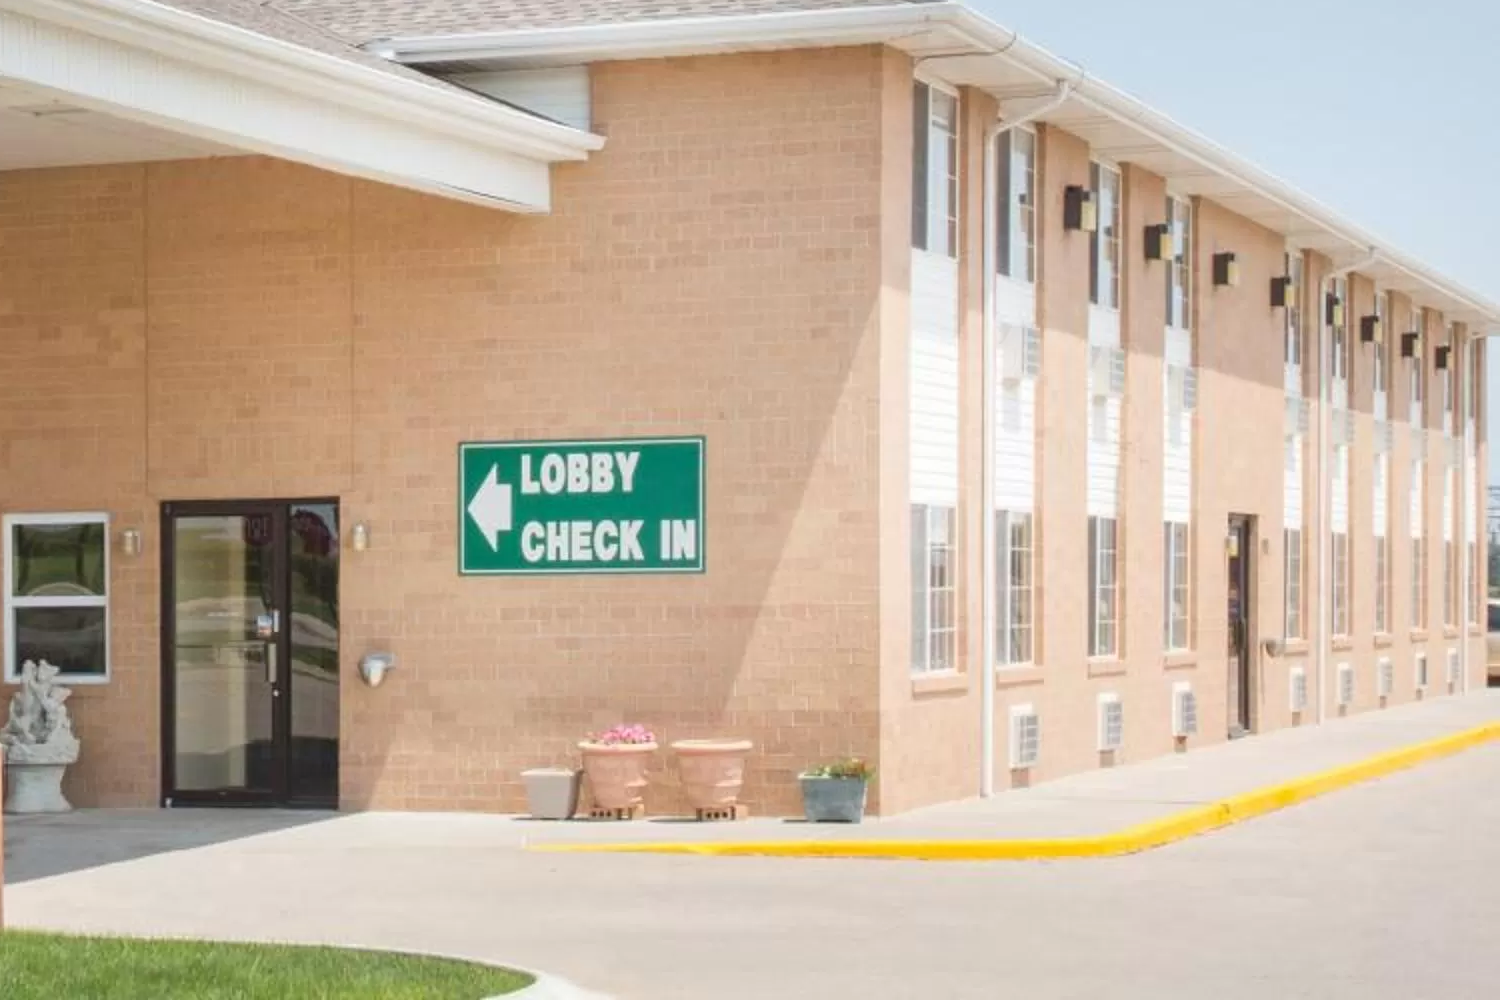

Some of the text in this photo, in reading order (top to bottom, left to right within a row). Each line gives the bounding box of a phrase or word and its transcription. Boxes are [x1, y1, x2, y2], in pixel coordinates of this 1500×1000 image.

[520, 451, 640, 494] LOBBY
[520, 519, 697, 562] CHECK IN
